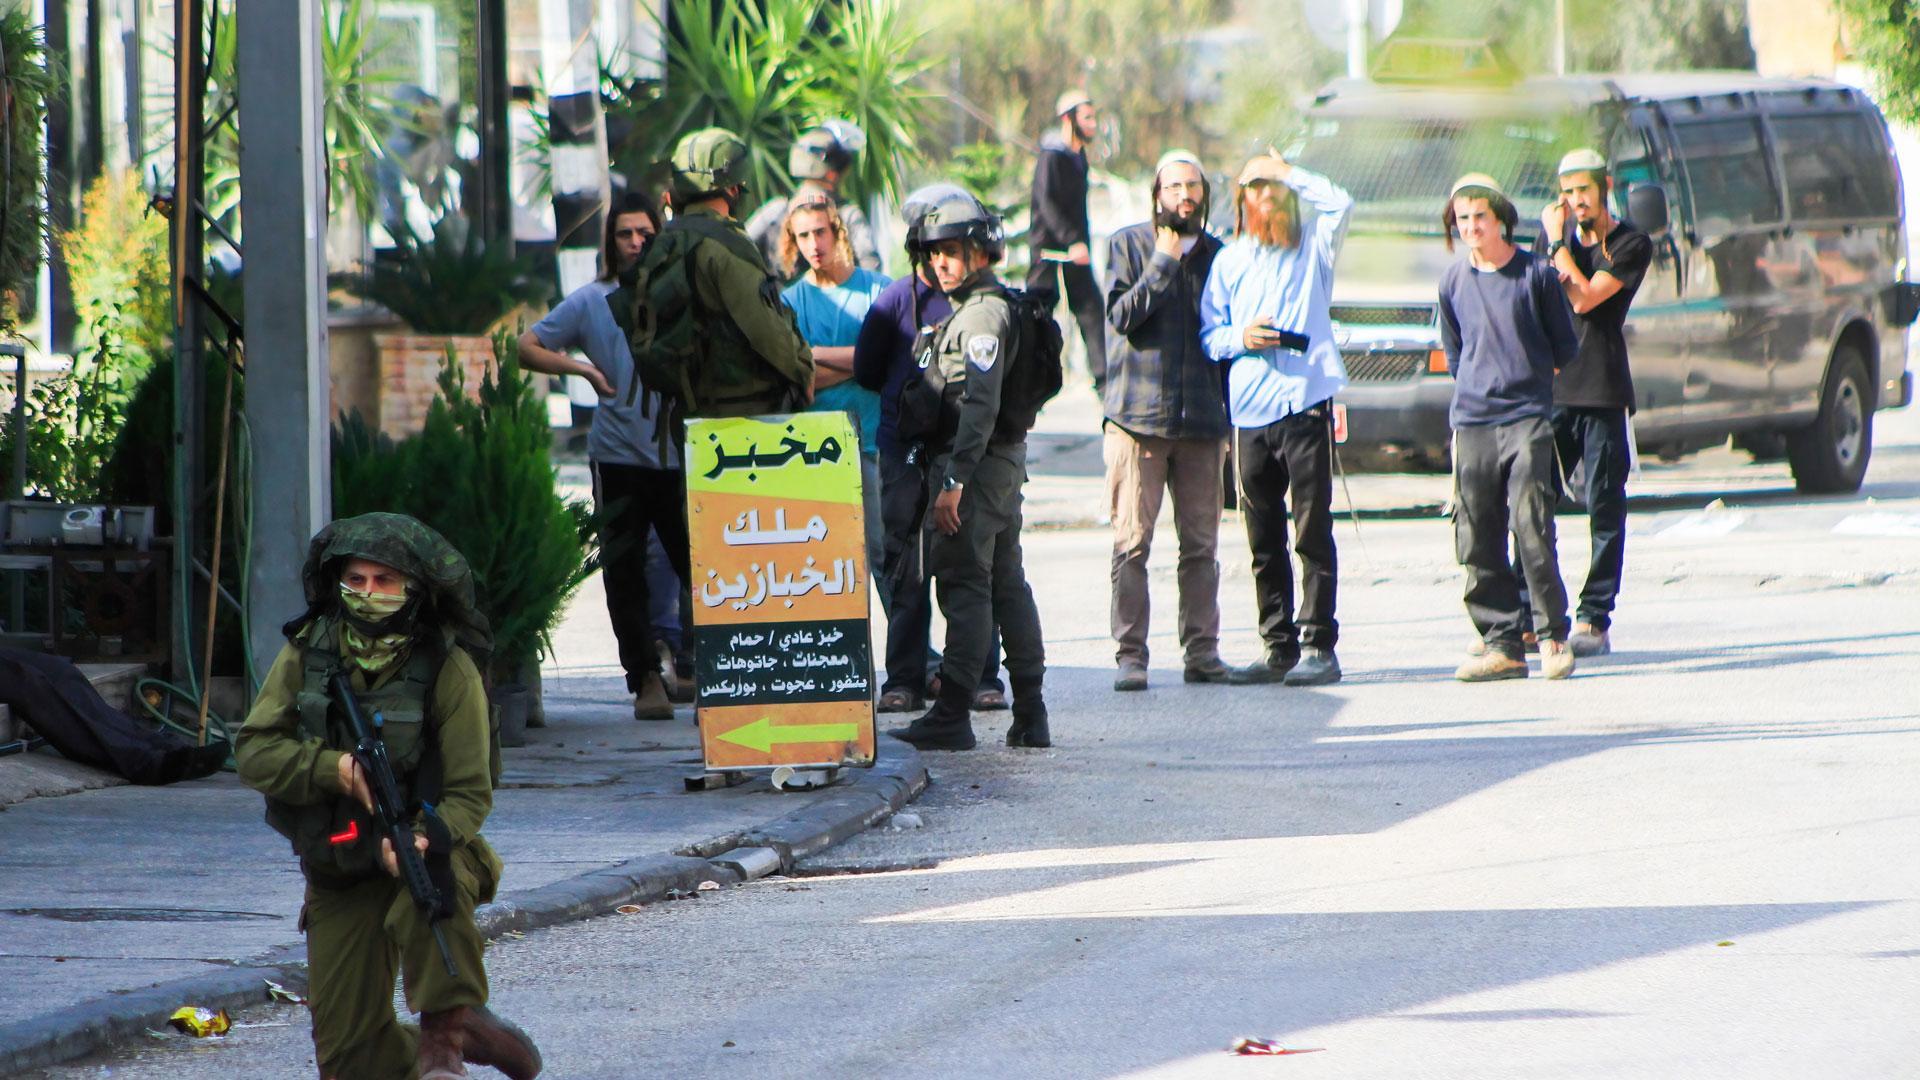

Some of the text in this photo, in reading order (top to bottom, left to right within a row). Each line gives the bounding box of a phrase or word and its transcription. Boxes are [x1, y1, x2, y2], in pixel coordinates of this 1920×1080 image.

[703, 424, 842, 482] مخبز
[723, 507, 829, 546] ملك
[702, 555, 856, 611] الخبازين
[730, 632, 765, 652] حمام
[779, 629, 814, 651] عادي
[818, 627, 844, 647] خبز
[716, 653, 778, 673] جاتوهات
[792, 652, 849, 669] معجنات
[771, 679, 816, 695] عجوت
[828, 674, 868, 693] بتفور
